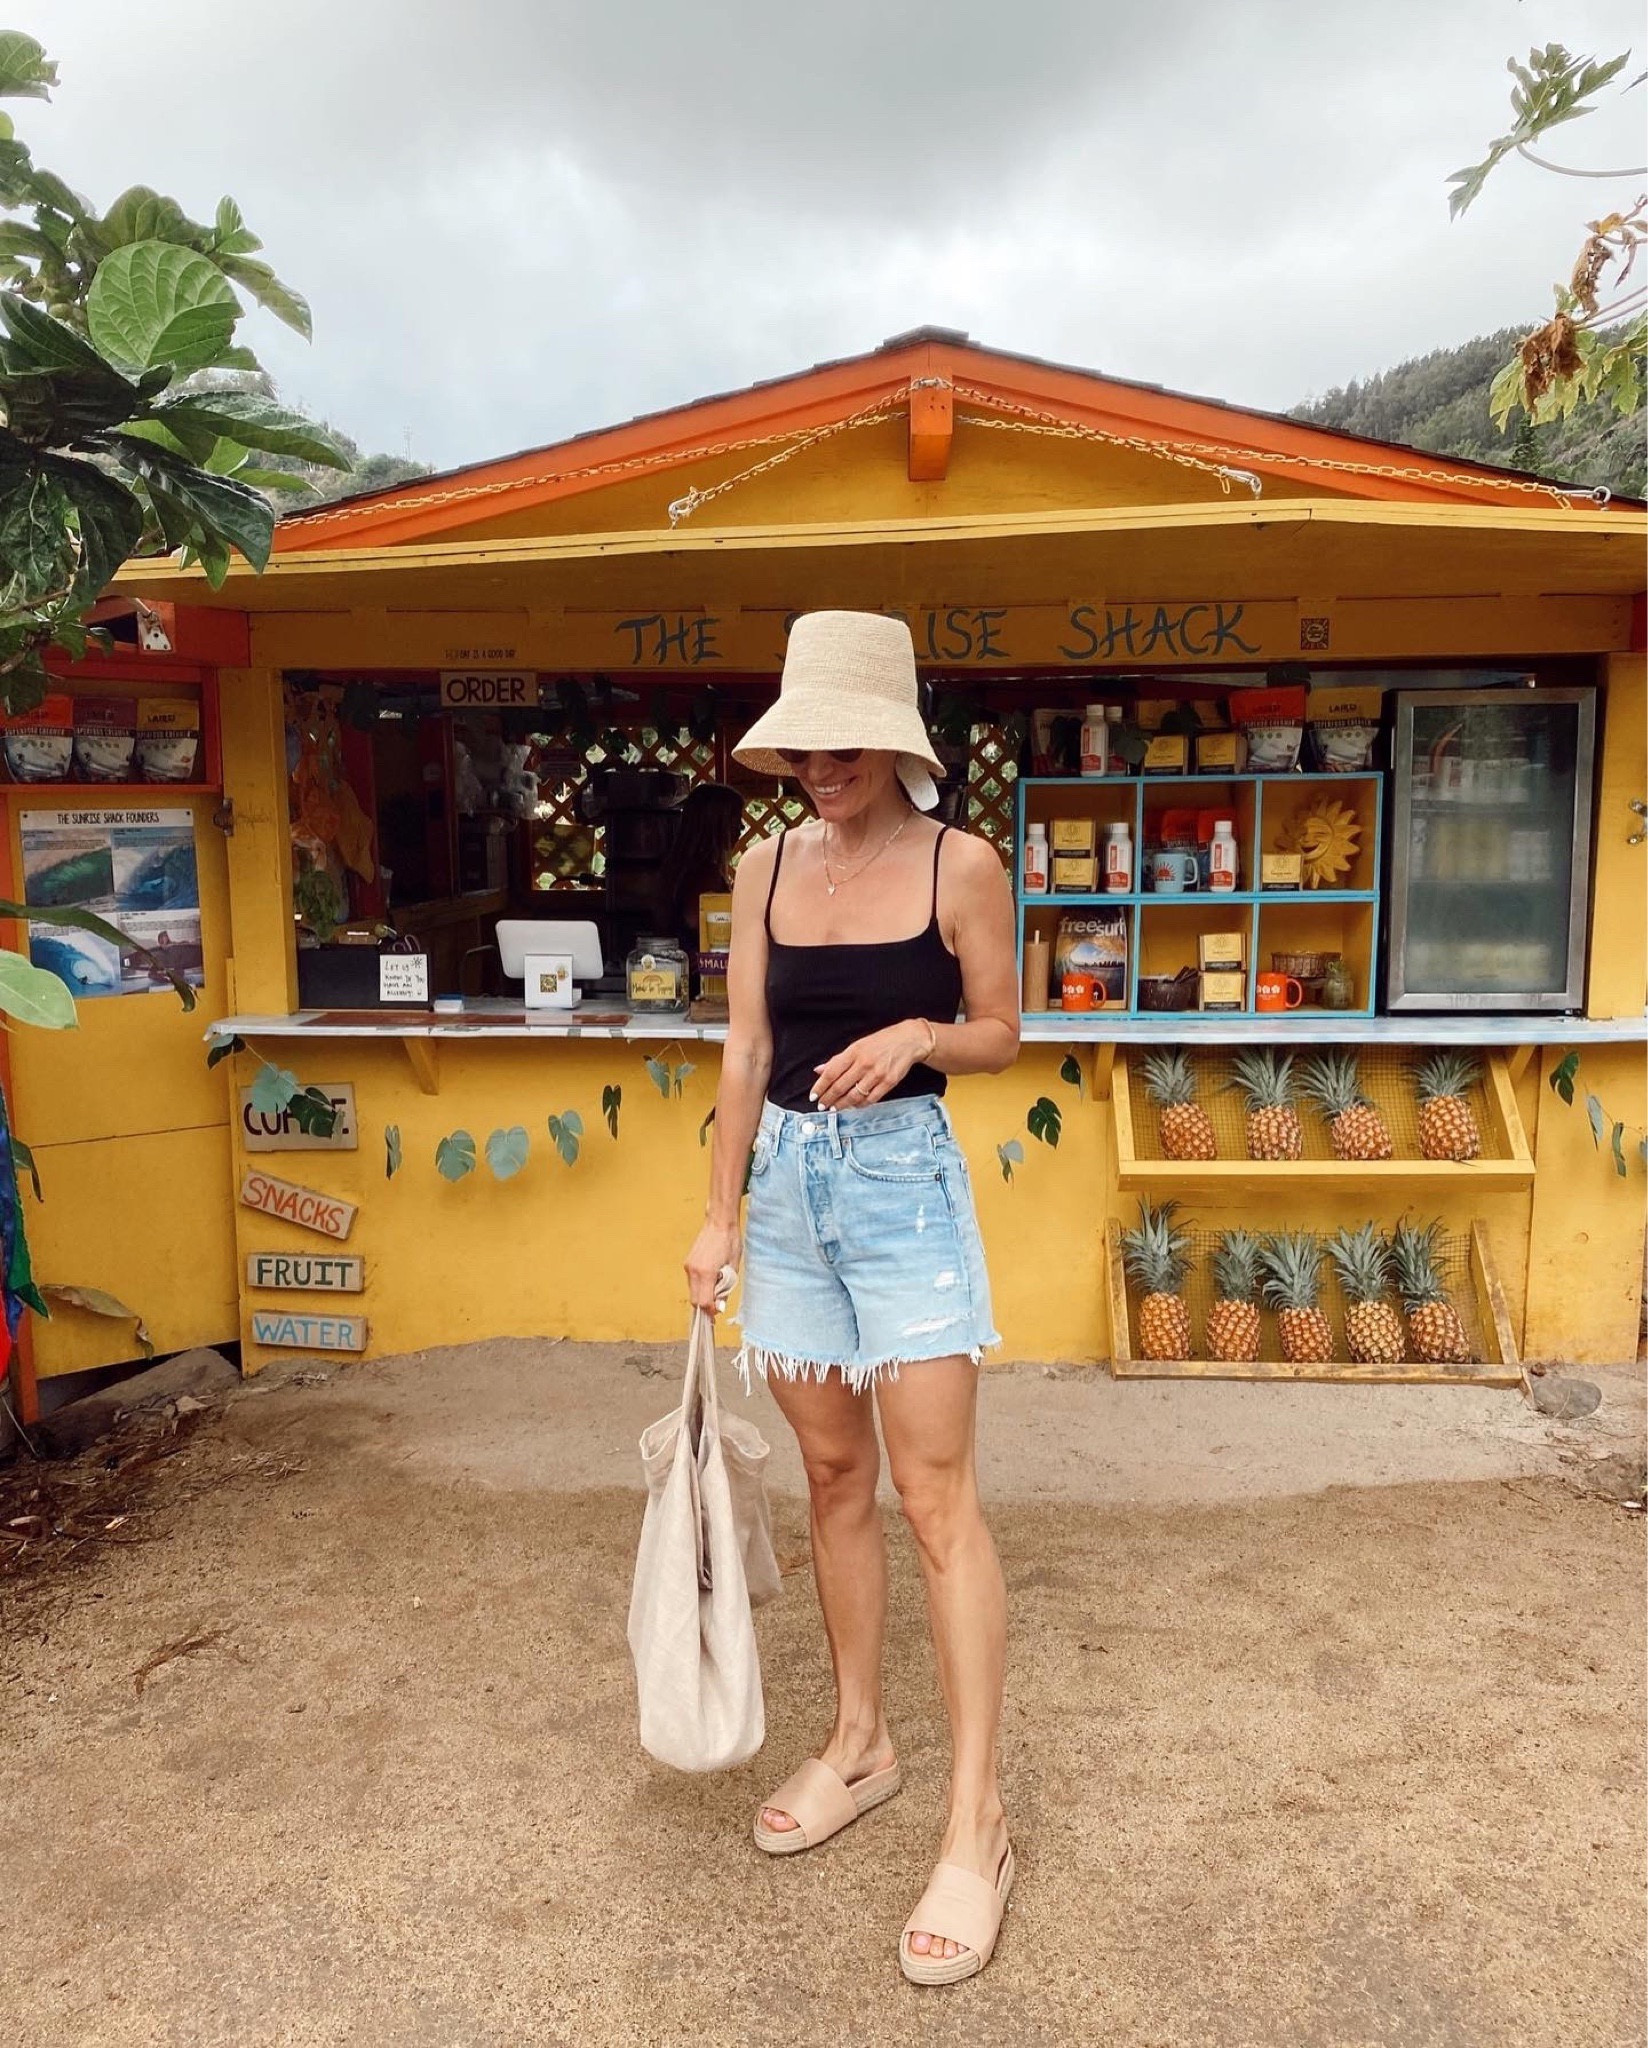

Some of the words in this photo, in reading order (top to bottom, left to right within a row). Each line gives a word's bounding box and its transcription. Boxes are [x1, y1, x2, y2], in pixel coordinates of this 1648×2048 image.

[614, 614, 723, 665] THE
[1060, 602, 1262, 660] SHACK
[446, 676, 526, 703] ORDER
[58, 814, 70, 825] THE
[72, 814, 101, 825] SUNRISE
[104, 813, 125, 825] SHACK
[126, 812, 160, 824] FOUNDERS
[243, 1177, 344, 1234] SNACKS
[257, 1258, 353, 1287] FRUIT
[254, 1316, 355, 1348] WATER
